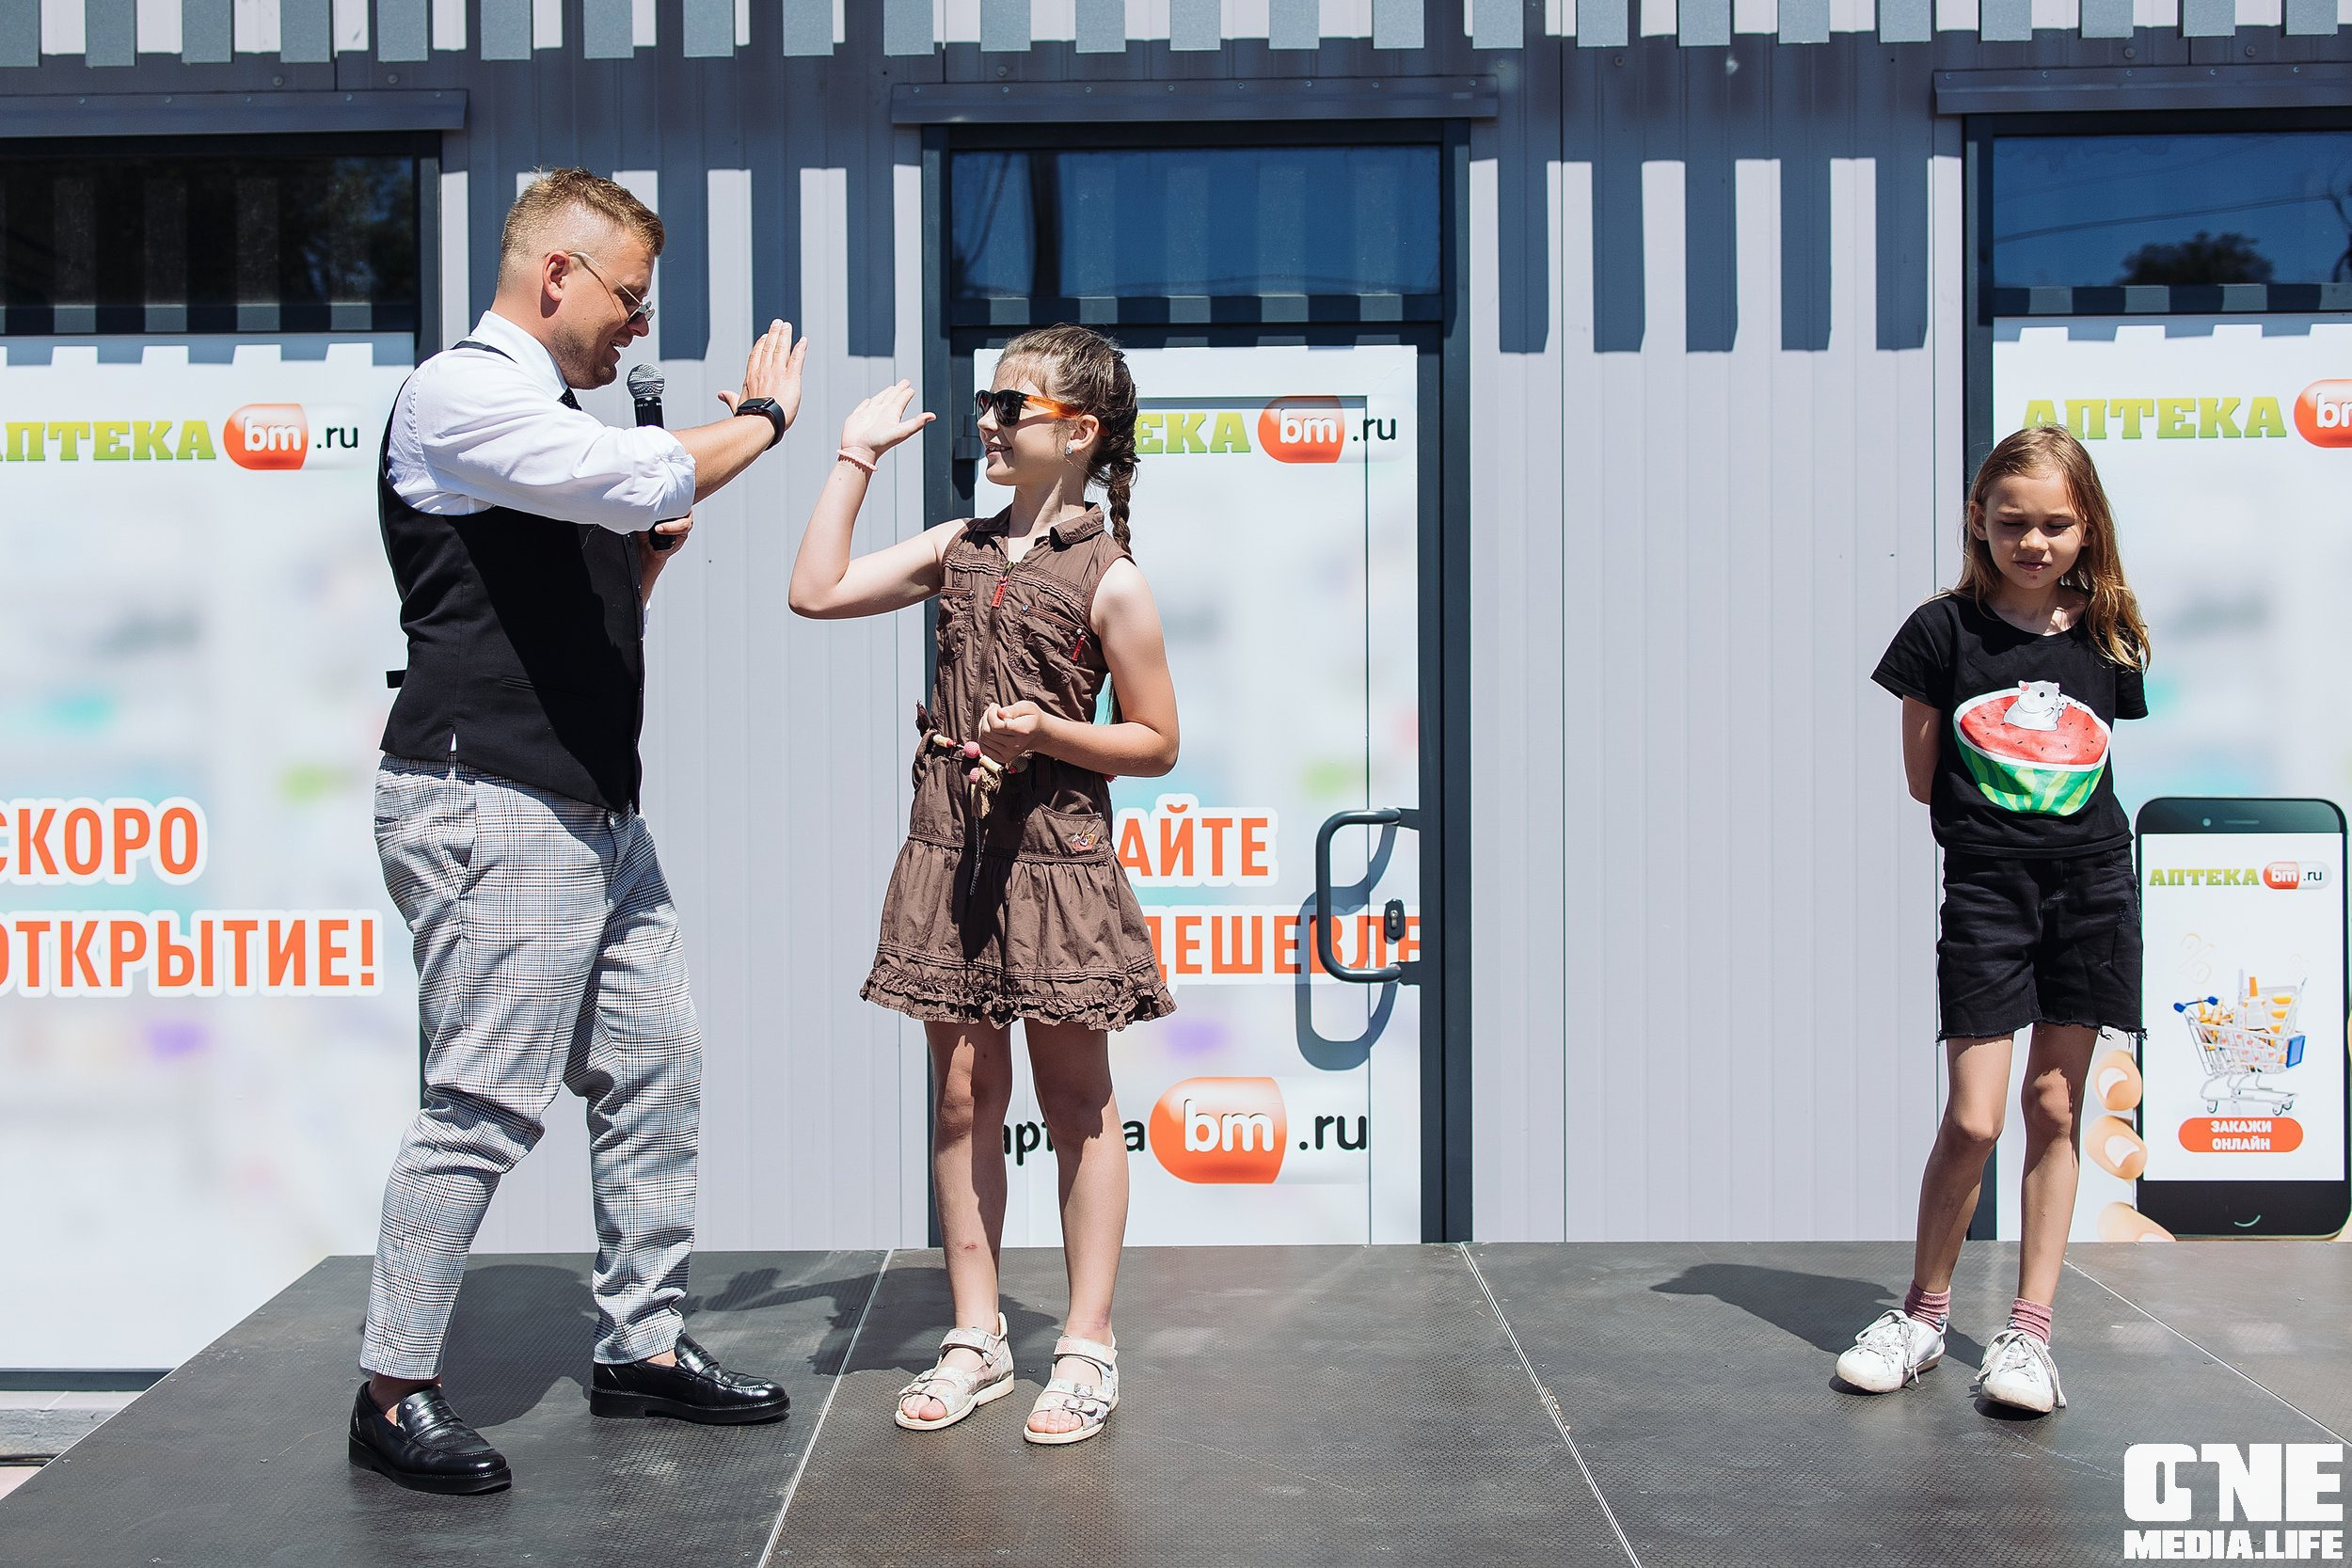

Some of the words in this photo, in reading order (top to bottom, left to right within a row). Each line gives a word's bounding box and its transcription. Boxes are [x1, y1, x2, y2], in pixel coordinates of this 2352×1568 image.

[1135, 412, 1251, 454] ЕКА
[2023, 396, 2287, 440] АПТЕКА
[0, 420, 216, 461] ПТЕКА
[0, 807, 199, 876] КОРО
[1118, 804, 1268, 877] АЙТЕ
[2149, 868, 2260, 886] АПТЕКА
[0, 919, 374, 988] ТКРЫТИЕ!
[2210, 1119, 2273, 1133] ЗАКАЖИ
[2211, 1135, 2271, 1150] ОНЛАЙН
